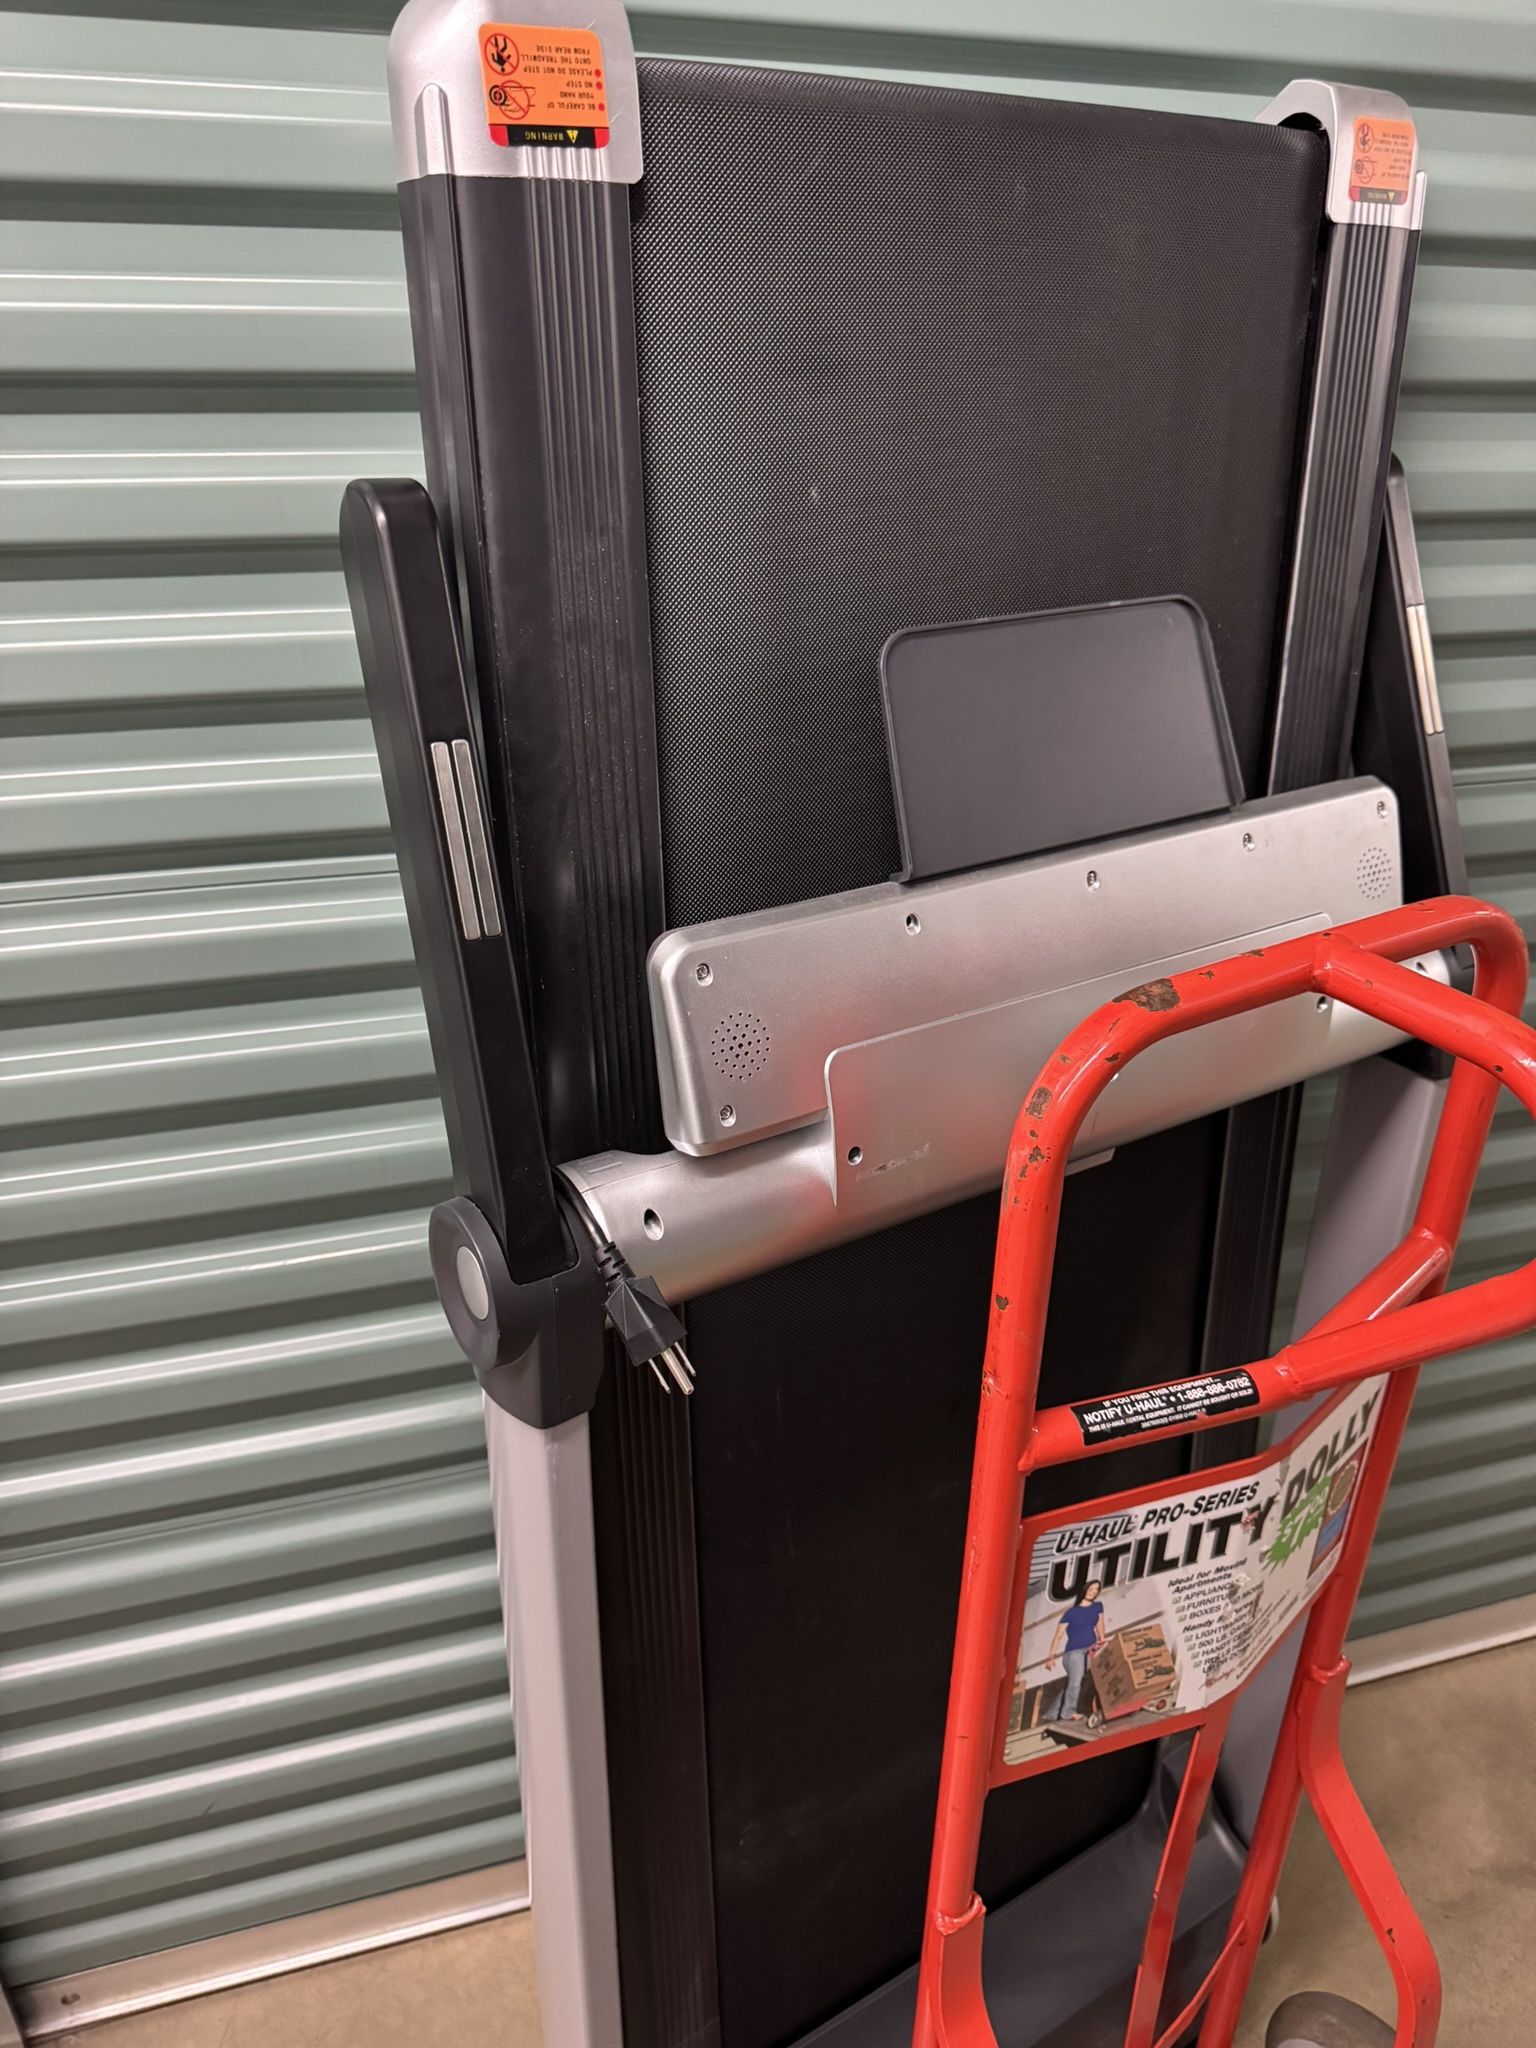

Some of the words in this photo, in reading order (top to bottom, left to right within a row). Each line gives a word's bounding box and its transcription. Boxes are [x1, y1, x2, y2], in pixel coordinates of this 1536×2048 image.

[555, 46, 571, 54] REAR
[574, 47, 590, 55] FROM
[521, 54, 557, 63] TREADMILL
[575, 57, 592, 65] ONTO
[523, 65, 540, 73] STEP
[543, 66, 555, 74] NOT
[568, 68, 592, 77] PLEASE
[566, 80, 582, 88] STEP
[578, 91, 594, 99] YOUR
[557, 102, 586, 110] CAREFUL
[589, 103, 596, 111] BE
[525, 130, 564, 141] WARNING
[1103, 1400, 1111, 1408] IF
[1112, 1396, 1130, 1405] YOU
[1130, 1392, 1150, 1402] FIND
[1149, 1387, 1170, 1397] THIS
[1182, 1400, 1203, 1410] CANNOT
[1083, 1406, 1123, 1424] NOTIFY
[1280, 1388, 1381, 1523] DOLLY
[1141, 1481, 1260, 1531] PRO-SERIES
[1047, 1493, 1279, 1601] UTILITY
[1168, 1574, 1195, 1588] Ideal
[1196, 1570, 1211, 1580] for
[1172, 1572, 1232, 1595] Apartments
[1189, 1604, 1222, 1620] BOXES
[1182, 1619, 1215, 1634] Handy
